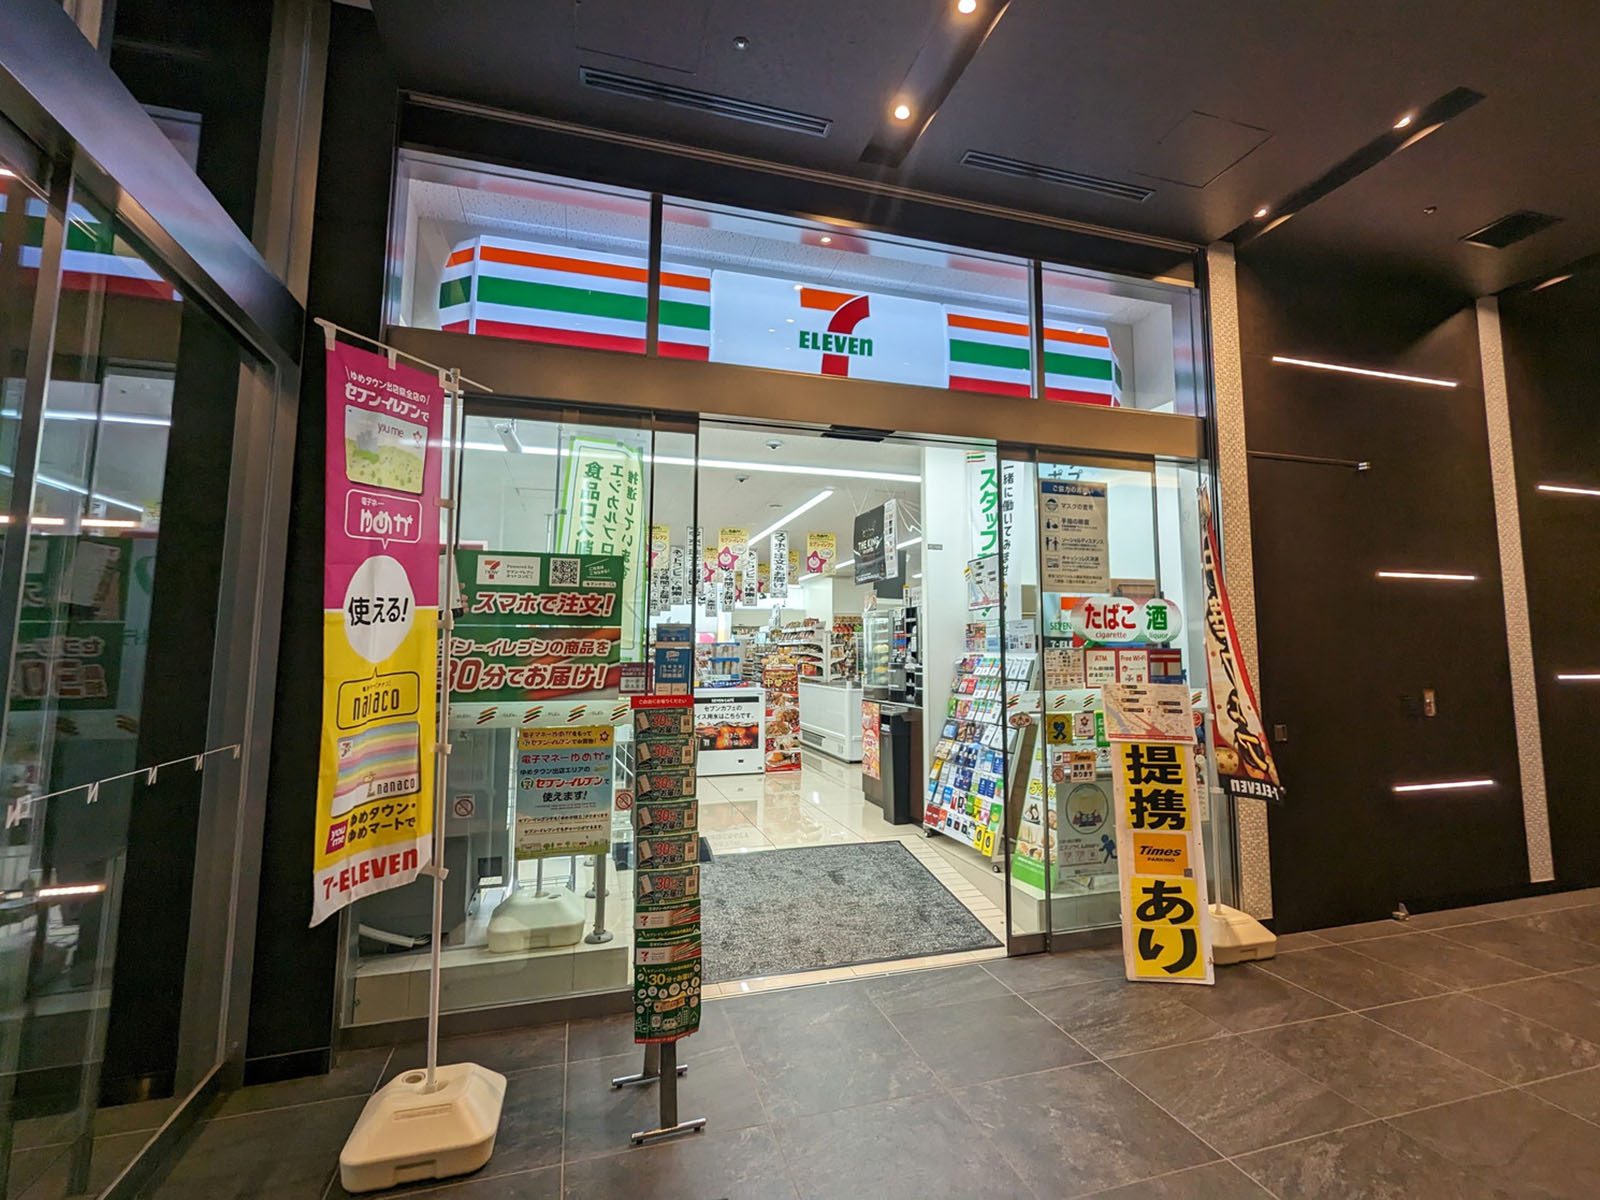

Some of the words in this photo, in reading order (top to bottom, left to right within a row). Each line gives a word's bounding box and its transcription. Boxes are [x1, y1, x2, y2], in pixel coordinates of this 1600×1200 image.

[800, 287, 870, 378] 7
[348, 597, 409, 626] 使える!
[473, 593, 615, 615] スマホで注文!
[1084, 603, 1136, 630] たばこ
[1146, 605, 1168, 631] 酒
[1095, 631, 1127, 639] cigarette
[439, 640, 609, 656] ブン-イレブンの商品を
[377, 778, 416, 795] nanaco
[542, 791, 588, 802] 使えます!
[1125, 744, 1187, 831] 提携
[348, 818, 416, 843] ゆめマートで
[1139, 845, 1182, 857] Times
[1136, 880, 1198, 974] あり
